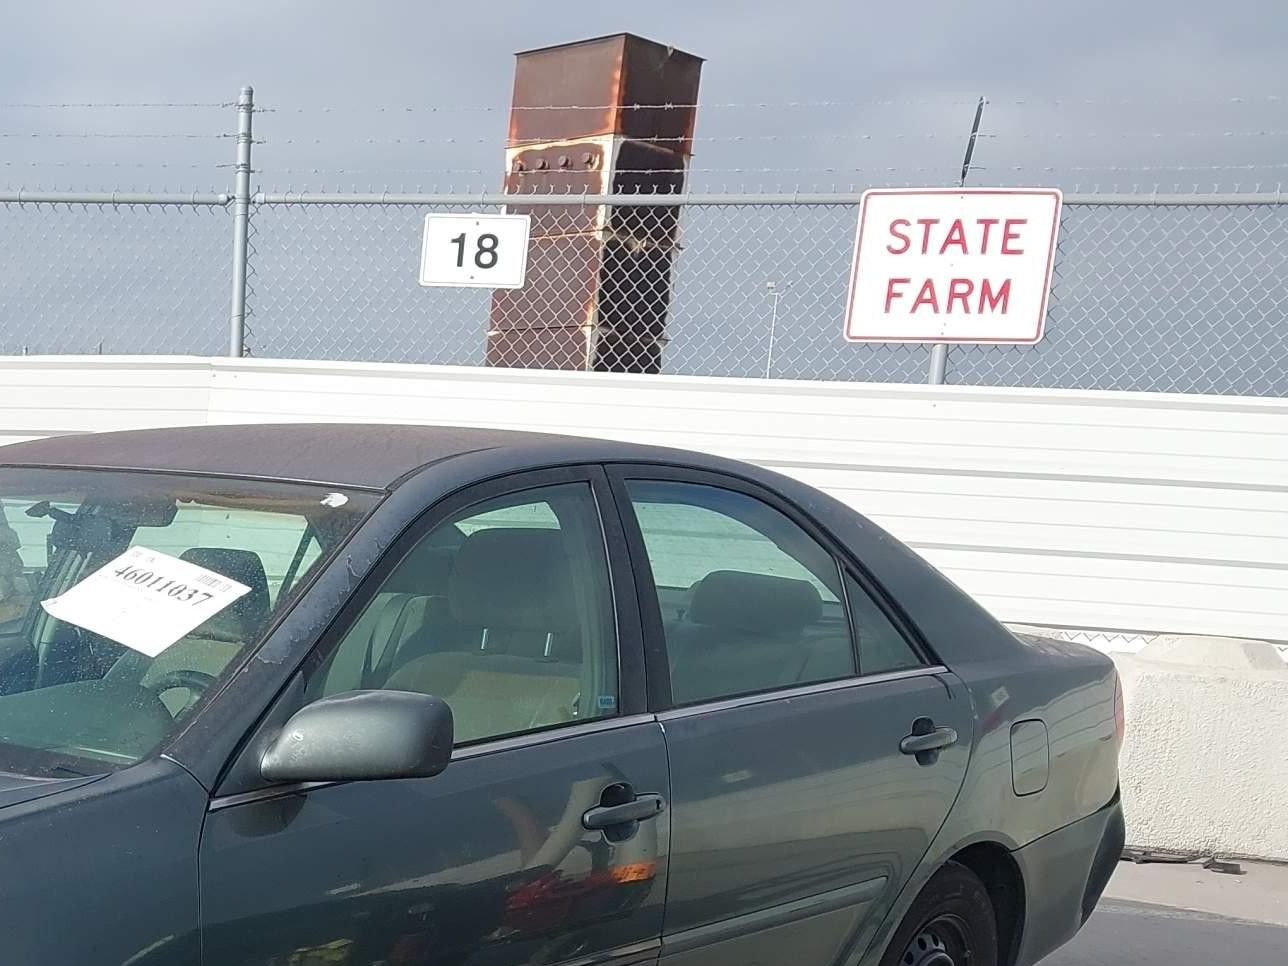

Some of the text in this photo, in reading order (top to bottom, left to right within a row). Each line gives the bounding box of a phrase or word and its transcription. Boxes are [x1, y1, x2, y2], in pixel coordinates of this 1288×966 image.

[450, 232, 500, 269] 18
[886, 218, 1026, 256] STATE
[883, 278, 1012, 314] FARM
[114, 564, 214, 607] 46011037
